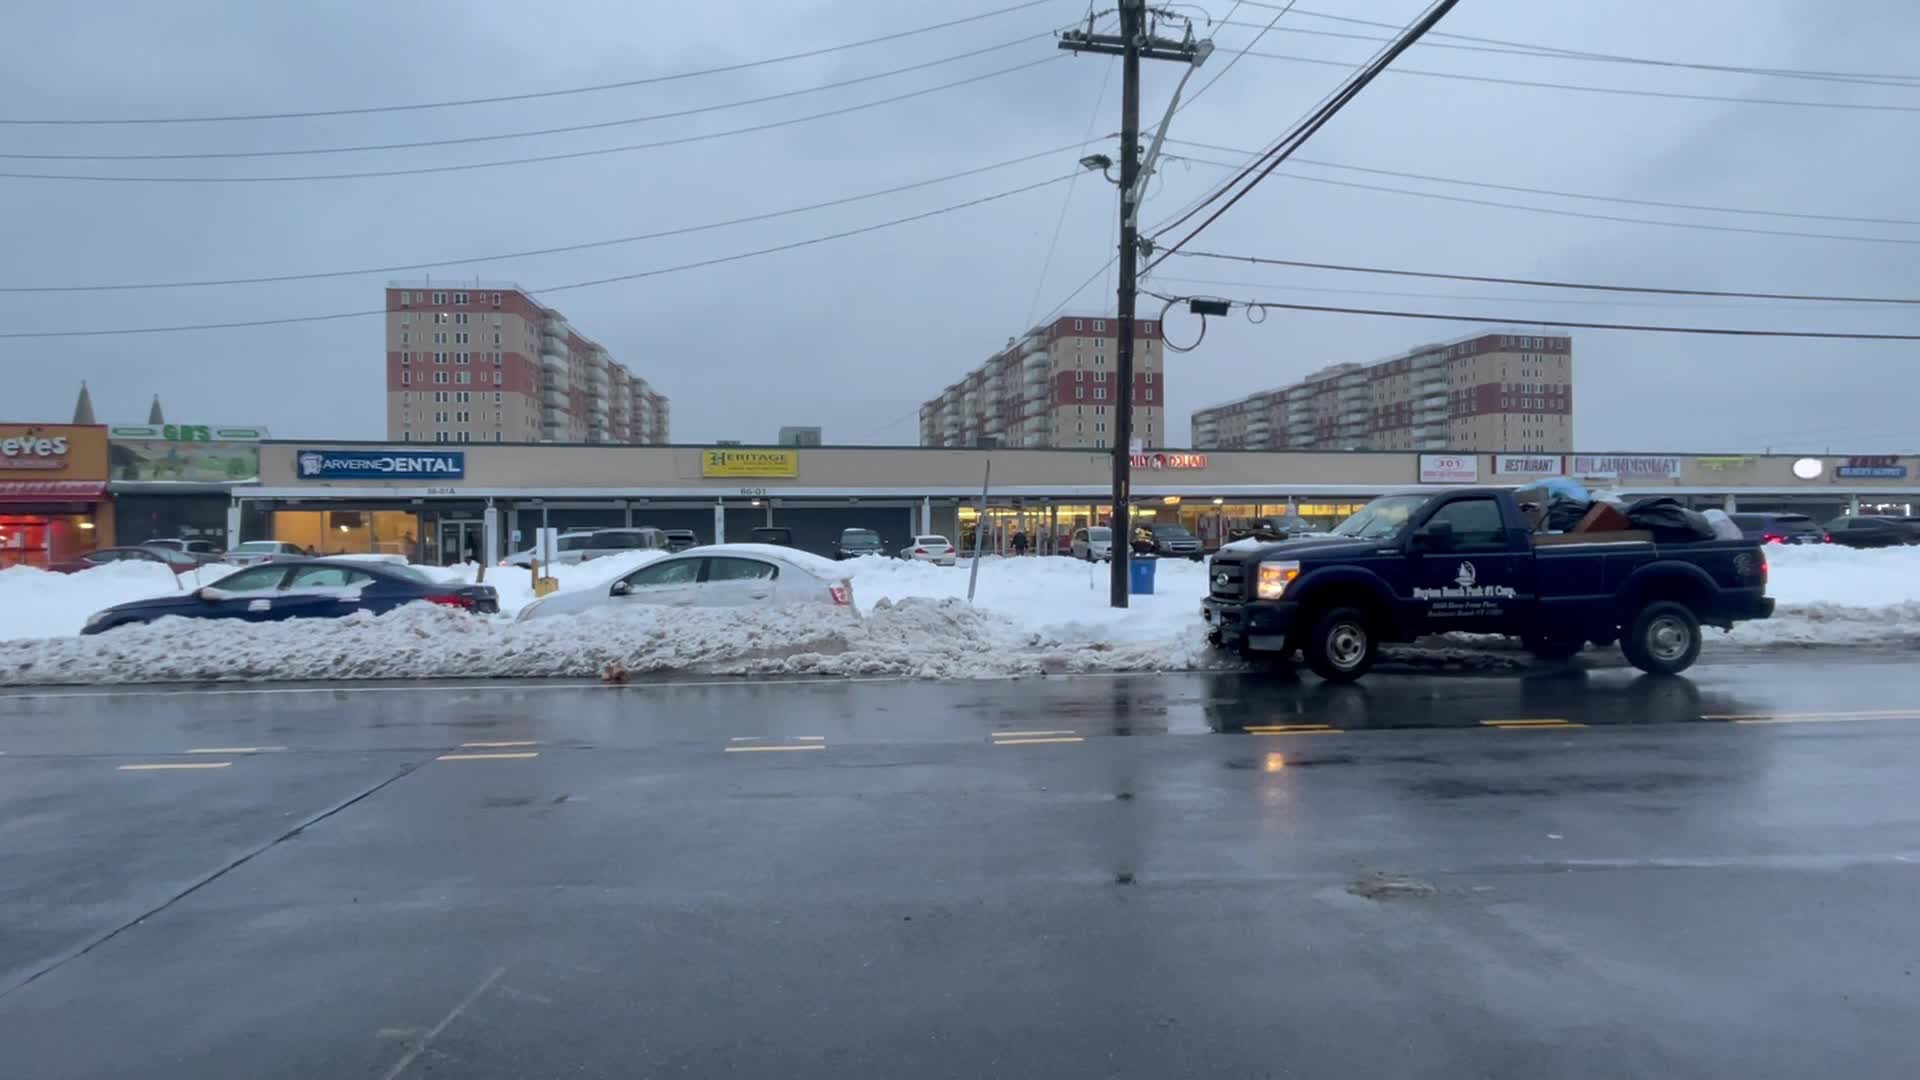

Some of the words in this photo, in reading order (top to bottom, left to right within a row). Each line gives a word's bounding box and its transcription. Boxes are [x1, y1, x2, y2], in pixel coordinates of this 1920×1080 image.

[322, 459, 382, 469] ARVERNE
[381, 458, 461, 472] DENTAL
[1168, 455, 1208, 469] DOLLAR
[1504, 459, 1553, 472] RESTAURANT
[1591, 457, 1678, 472] LAUNDROMAT
